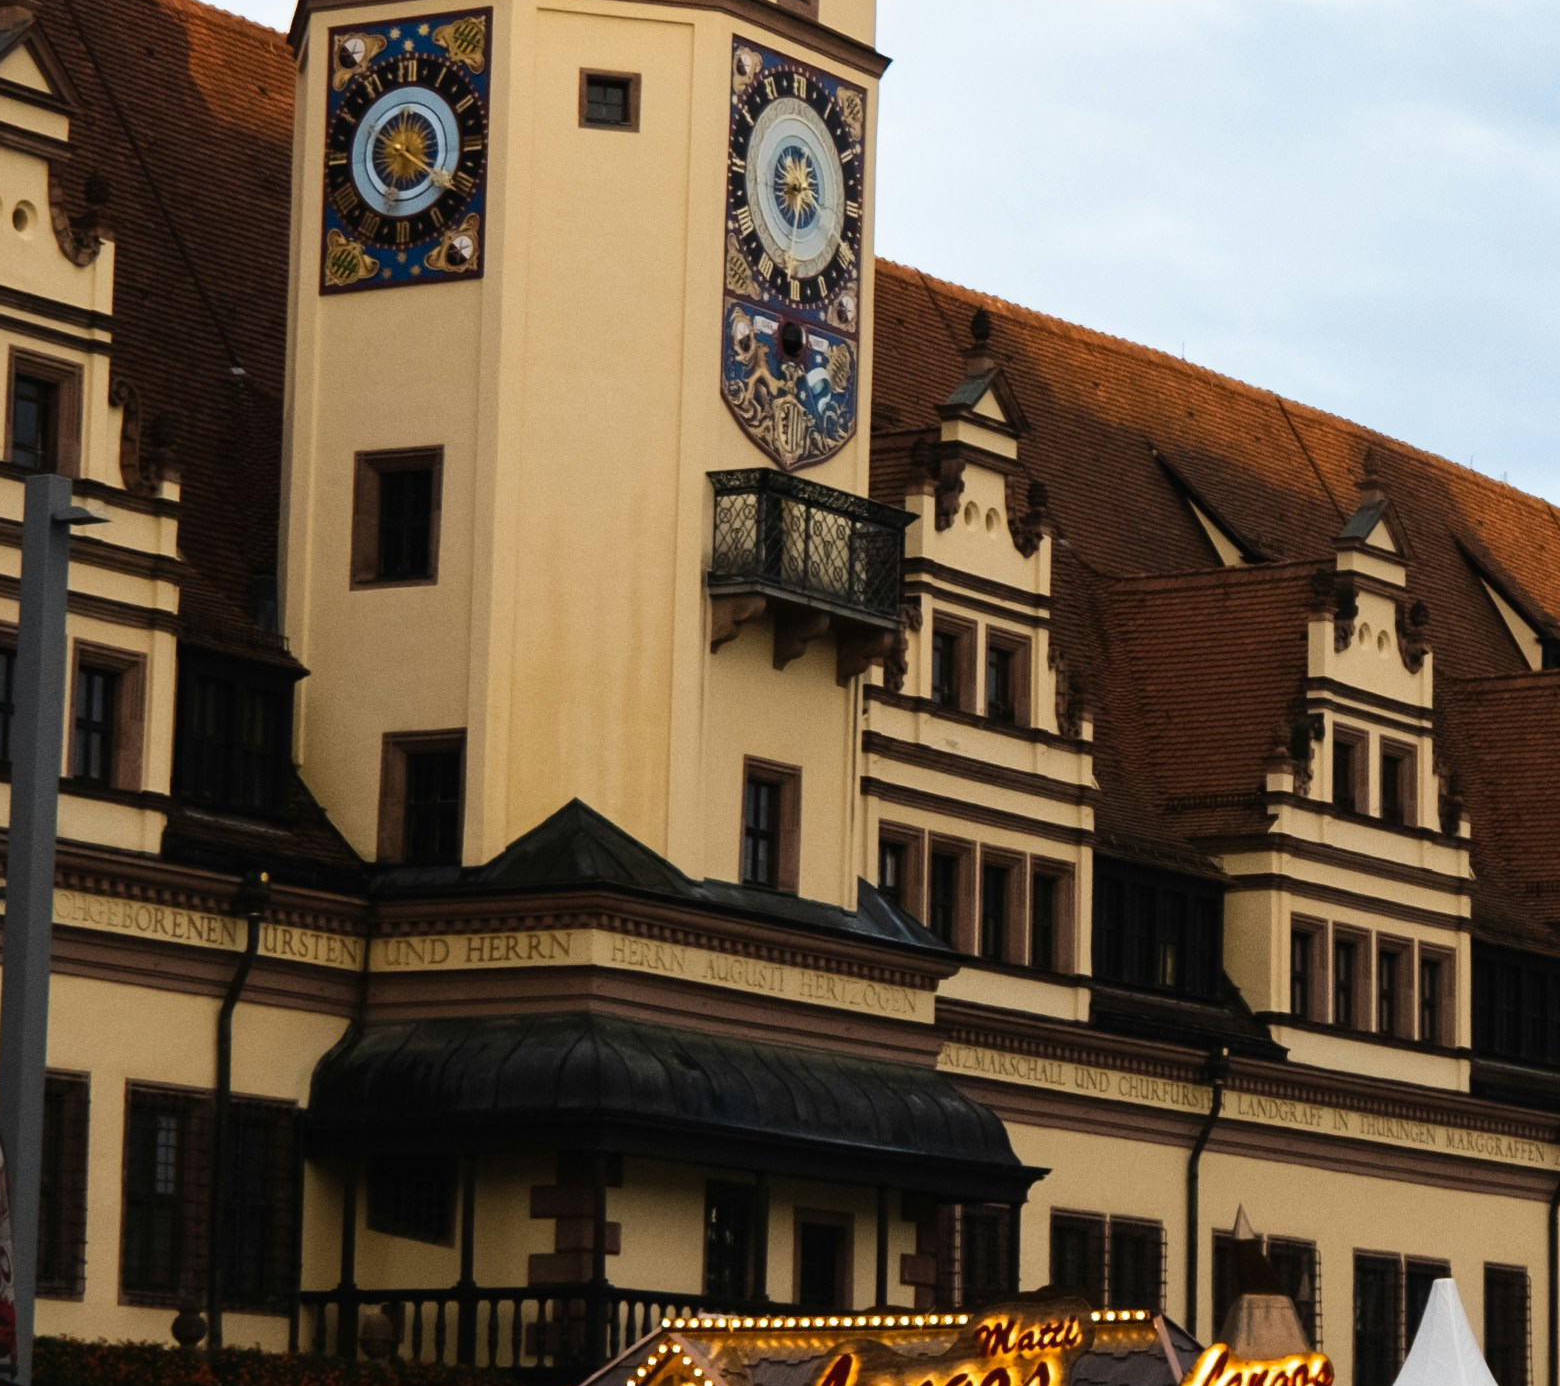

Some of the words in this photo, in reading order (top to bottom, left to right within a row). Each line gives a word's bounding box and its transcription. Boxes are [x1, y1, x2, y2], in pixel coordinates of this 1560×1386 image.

[261, 922, 360, 965] URSTEN
[383, 936, 450, 967] UND
[465, 932, 572, 964] HERRN
[611, 936, 686, 975] HERRN
[940, 1044, 1066, 1085] RTZMARSCHALL
[1074, 1069, 1111, 1094] UND
[1238, 1094, 1324, 1130] LANDGRAFF
[1333, 1109, 1350, 1132] IN
[973, 1315, 1083, 1358] Matti
